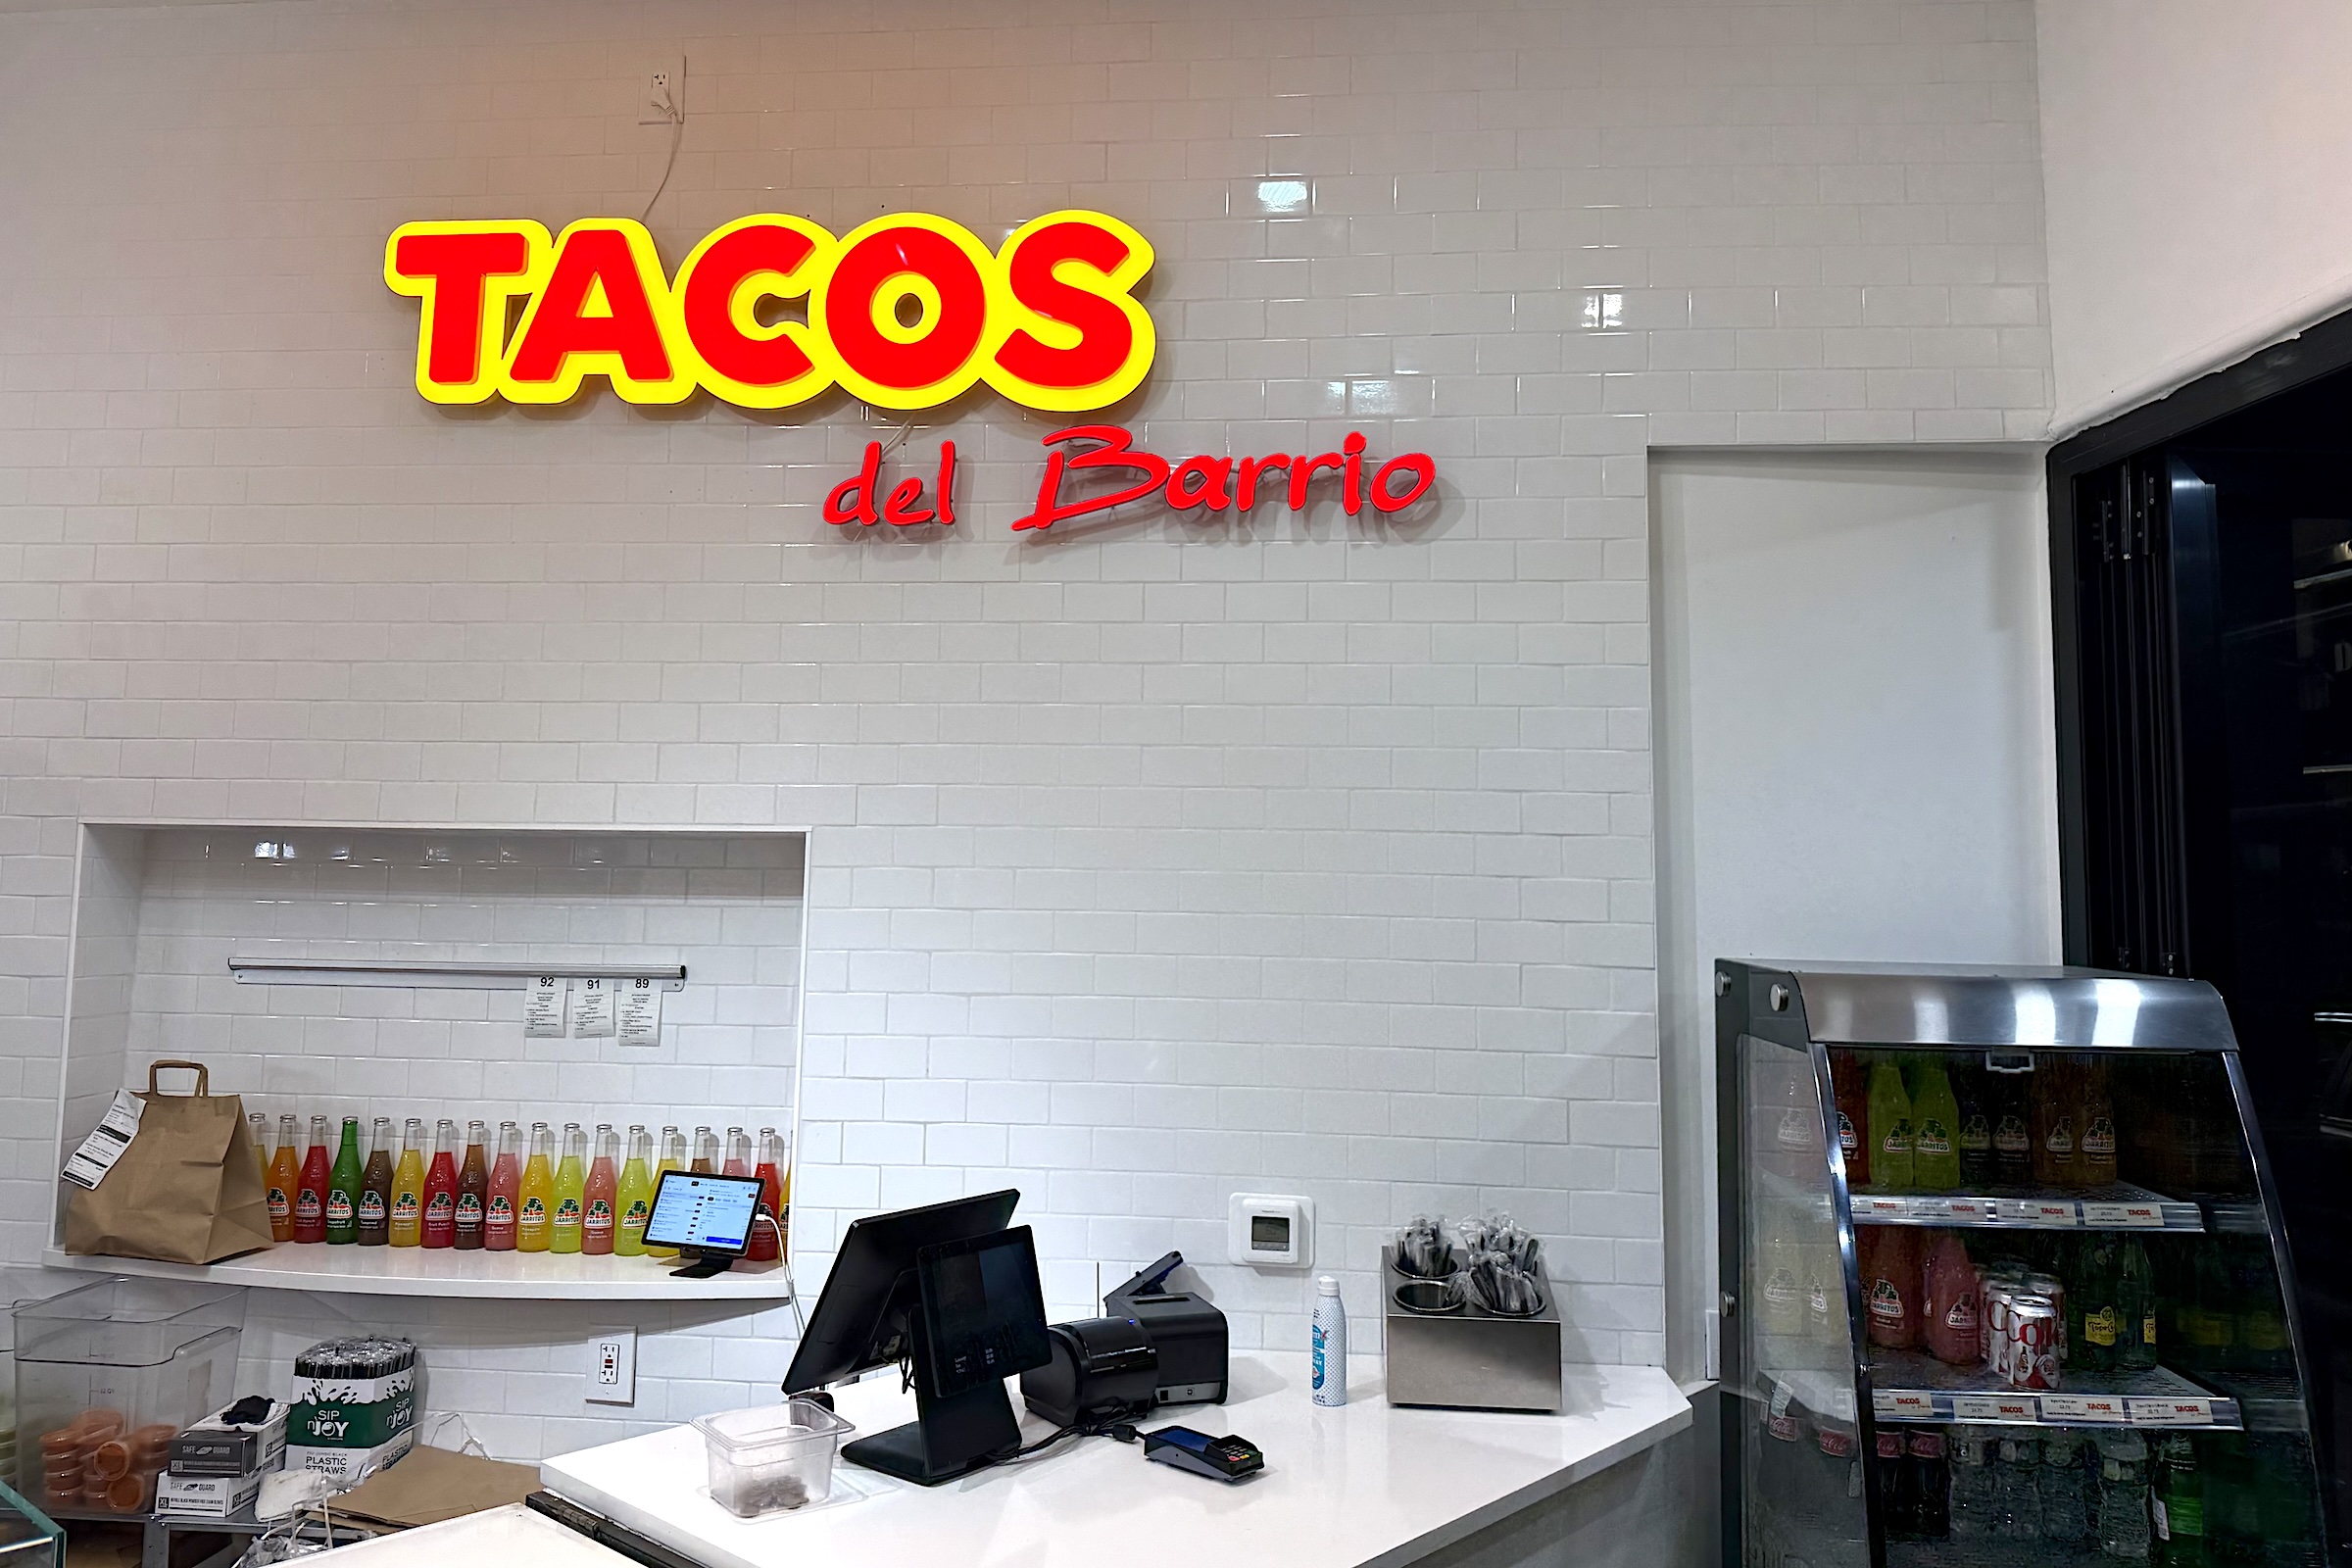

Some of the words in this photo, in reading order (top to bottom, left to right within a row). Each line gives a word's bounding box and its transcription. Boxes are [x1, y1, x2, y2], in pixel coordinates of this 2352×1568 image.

[396, 221, 1132, 388] TACOS
[824, 440, 955, 526] del
[1012, 425, 1436, 531] Barrio
[540, 977, 555, 987] 92
[587, 979, 600, 989] 91
[635, 978, 650, 989] 89
[396, 1397, 410, 1411] SIP
[2086, 1402, 2111, 1411] TACOS
[1999, 1405, 2024, 1414] TACOS
[318, 1409, 340, 1421] SIP
[182, 1446, 196, 1454] SAFE
[213, 1446, 231, 1454] GUARD
[305, 1456, 347, 1466] PLASTIC
[170, 1482, 183, 1491] SAFE
[160, 1498, 169, 1507] XL
